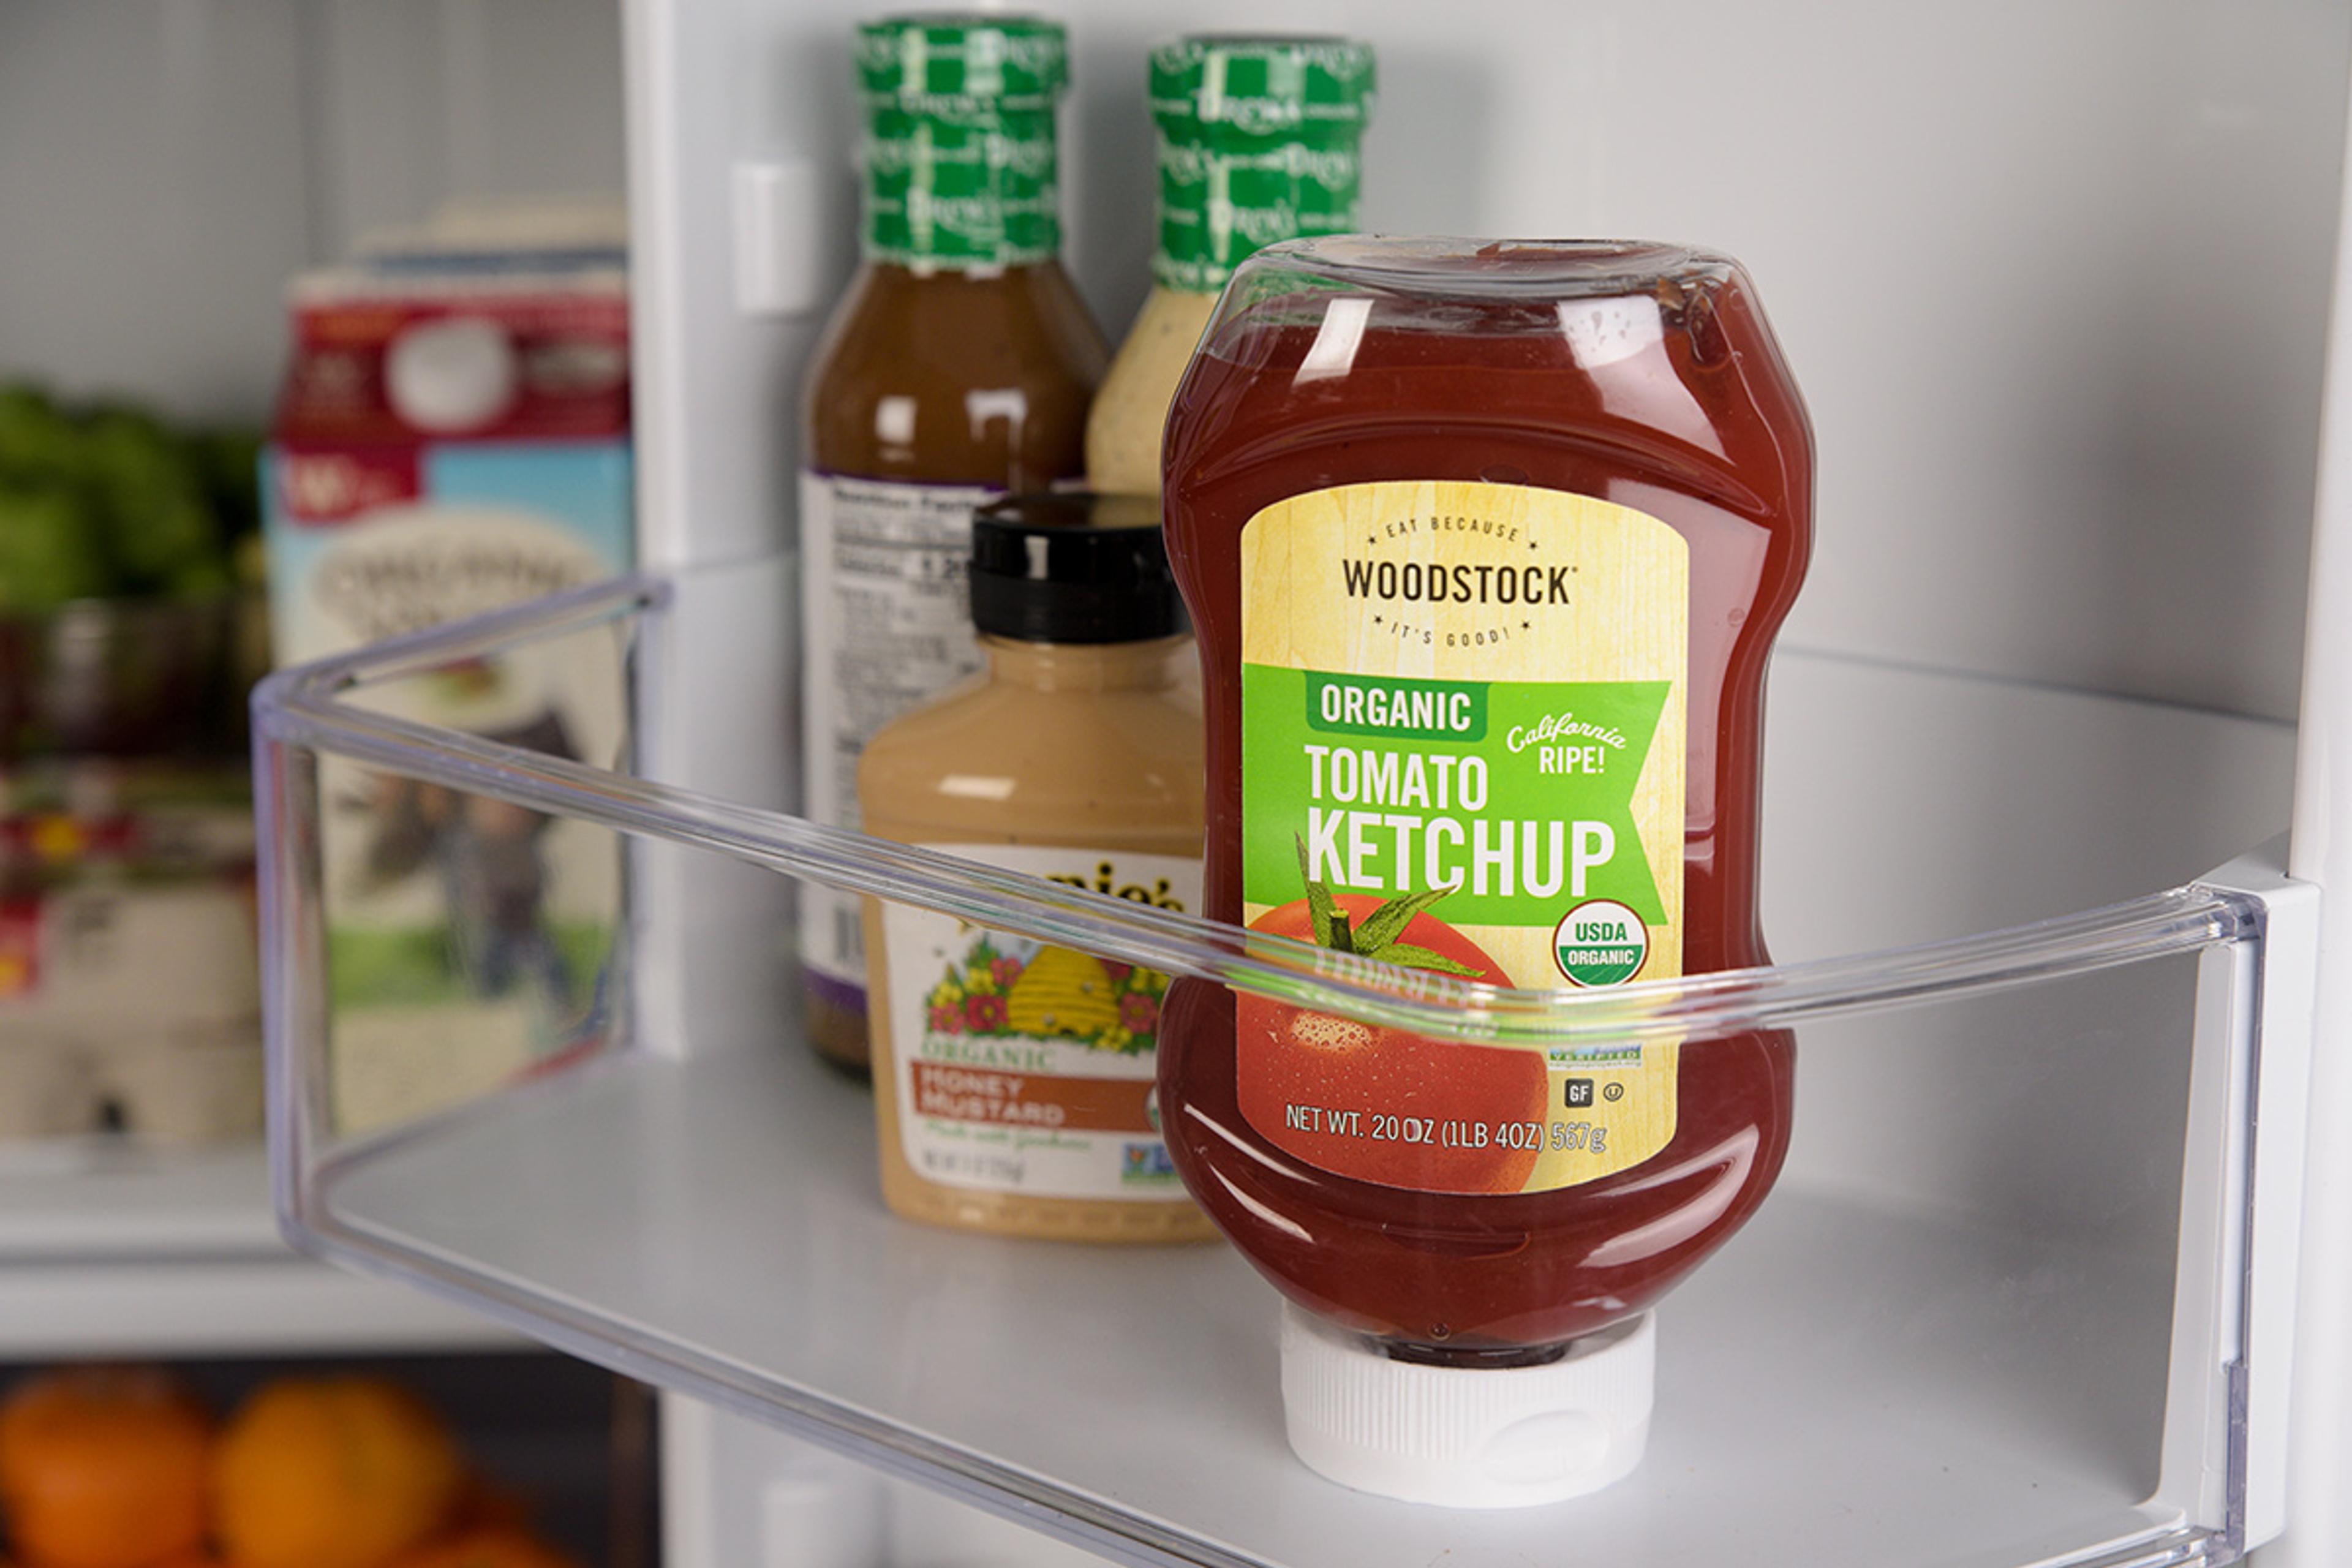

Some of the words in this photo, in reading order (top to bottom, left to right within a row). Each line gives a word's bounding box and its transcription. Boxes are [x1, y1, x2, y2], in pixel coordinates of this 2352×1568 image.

[1385, 519, 1417, 538] EAT
[1431, 516, 1518, 542] BECAUSE
[1342, 559, 1570, 605] WOODSTOCK
[1391, 621, 1432, 644] IT'S
[1446, 627, 1510, 647] GOOD!
[1321, 684, 1471, 731] ORGANIC
[1506, 712, 1627, 753] California
[1539, 746, 1605, 774] RIPE!
[1304, 744, 1488, 812] TOMATO
[1308, 807, 1616, 898] KETCHUP
[1575, 922, 1628, 941] USDA
[1567, 949, 1635, 966] ORGANIC
[921, 1041, 1057, 1071] ORGANIC
[921, 1066, 1024, 1099] HONEY
[1569, 1085, 1590, 1102] GF
[921, 1092, 1066, 1126] MUSTARD
[1286, 1104, 1322, 1132] NET
[1327, 1109, 1365, 1137] WT.
[1371, 1115, 1400, 1141] 20
[1403, 1118, 1435, 1145] OZ
[1441, 1120, 1489, 1149] (1LB
[1494, 1121, 1545, 1153] 4OZ)
[1551, 1121, 1608, 1154] 567g
